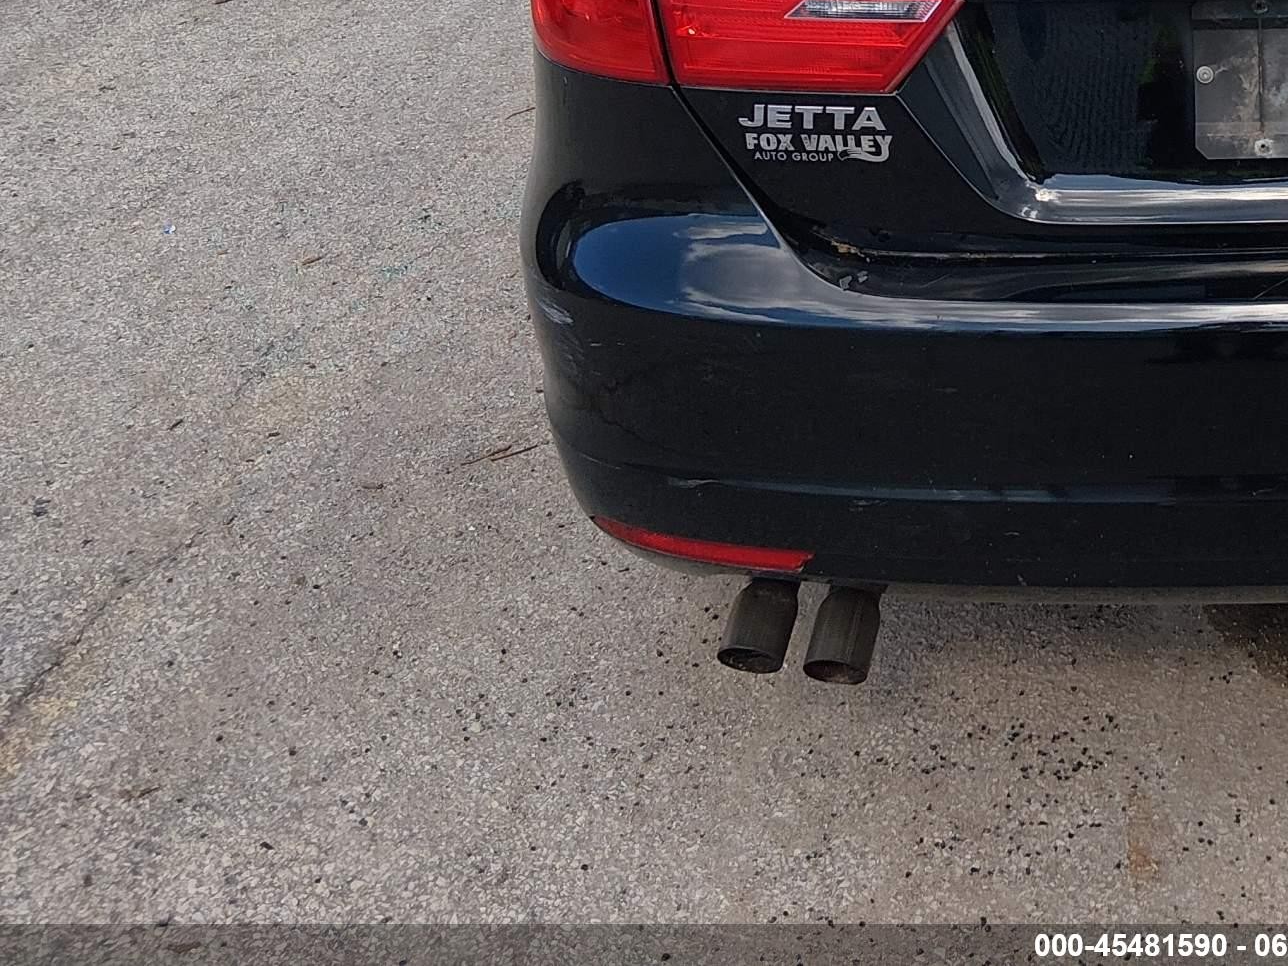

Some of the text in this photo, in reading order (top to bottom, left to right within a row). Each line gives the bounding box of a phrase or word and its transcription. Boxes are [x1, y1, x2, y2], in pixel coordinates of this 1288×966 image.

[738, 104, 886, 130] JETTA
[745, 132, 893, 162] FOX VALLEY
[754, 151, 834, 162] AUTO GROUP
